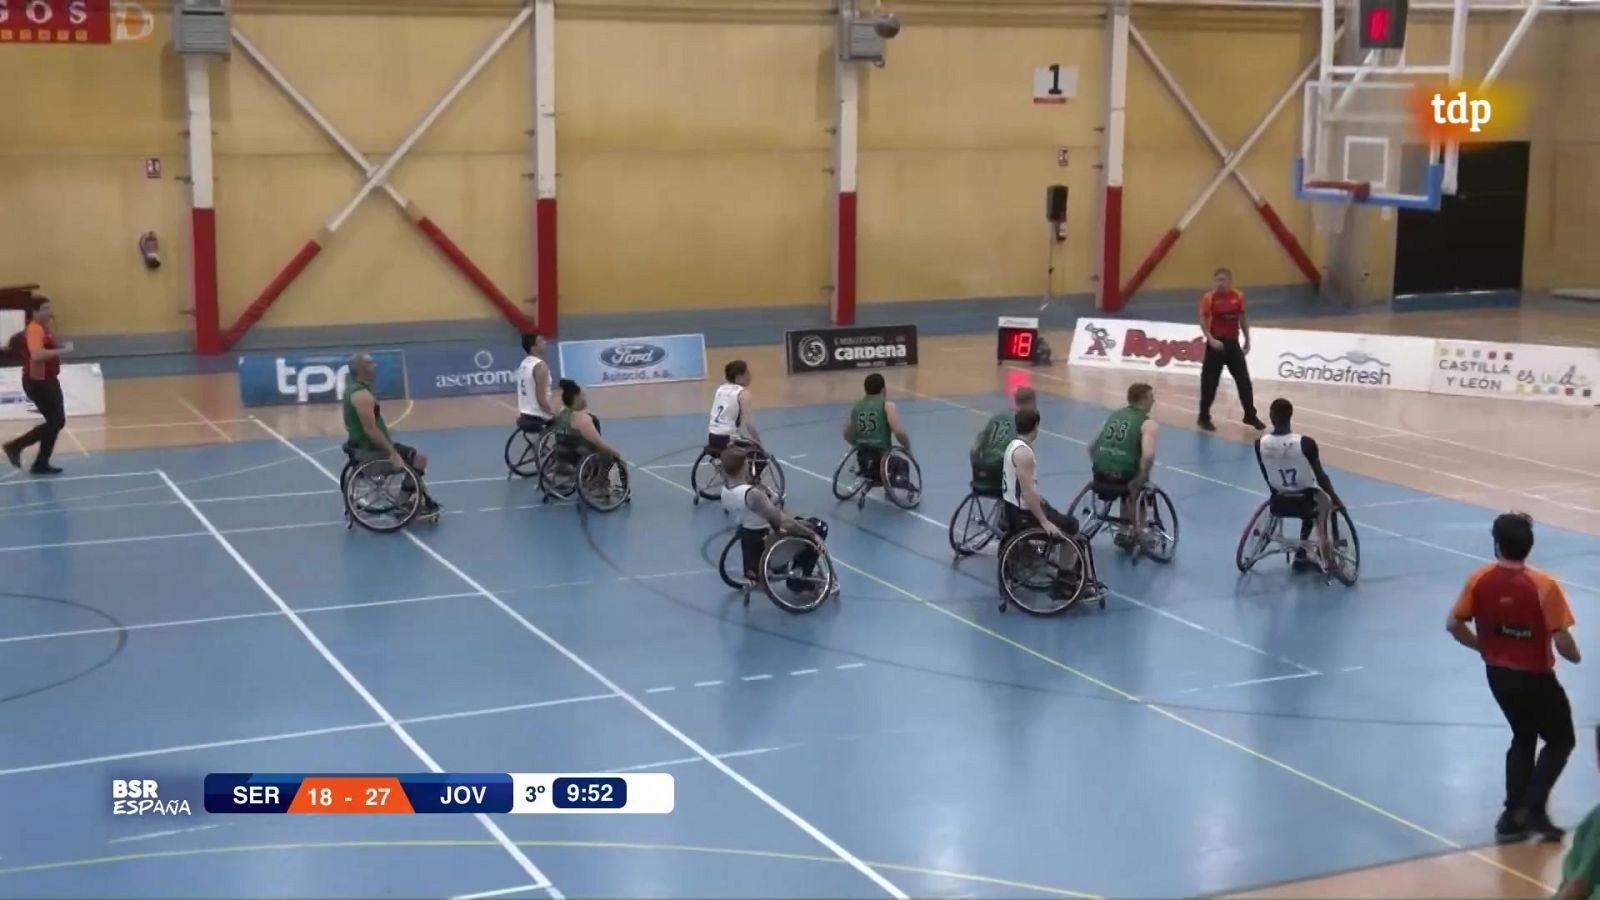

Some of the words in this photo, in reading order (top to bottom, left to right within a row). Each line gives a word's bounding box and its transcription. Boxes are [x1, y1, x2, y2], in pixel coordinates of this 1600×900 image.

[1048, 64, 1062, 95] 1
[611, 346, 654, 364] Ford
[1012, 332, 1032, 357] 18
[1278, 360, 1392, 385] Gambafresh
[1438, 359, 1511, 374] CASTILLA
[1446, 377, 1455, 386] Y
[1460, 376, 1502, 390] LEÓN
[714, 405, 727, 424] 2
[858, 411, 878, 433] 55
[1279, 467, 1298, 488] 17
